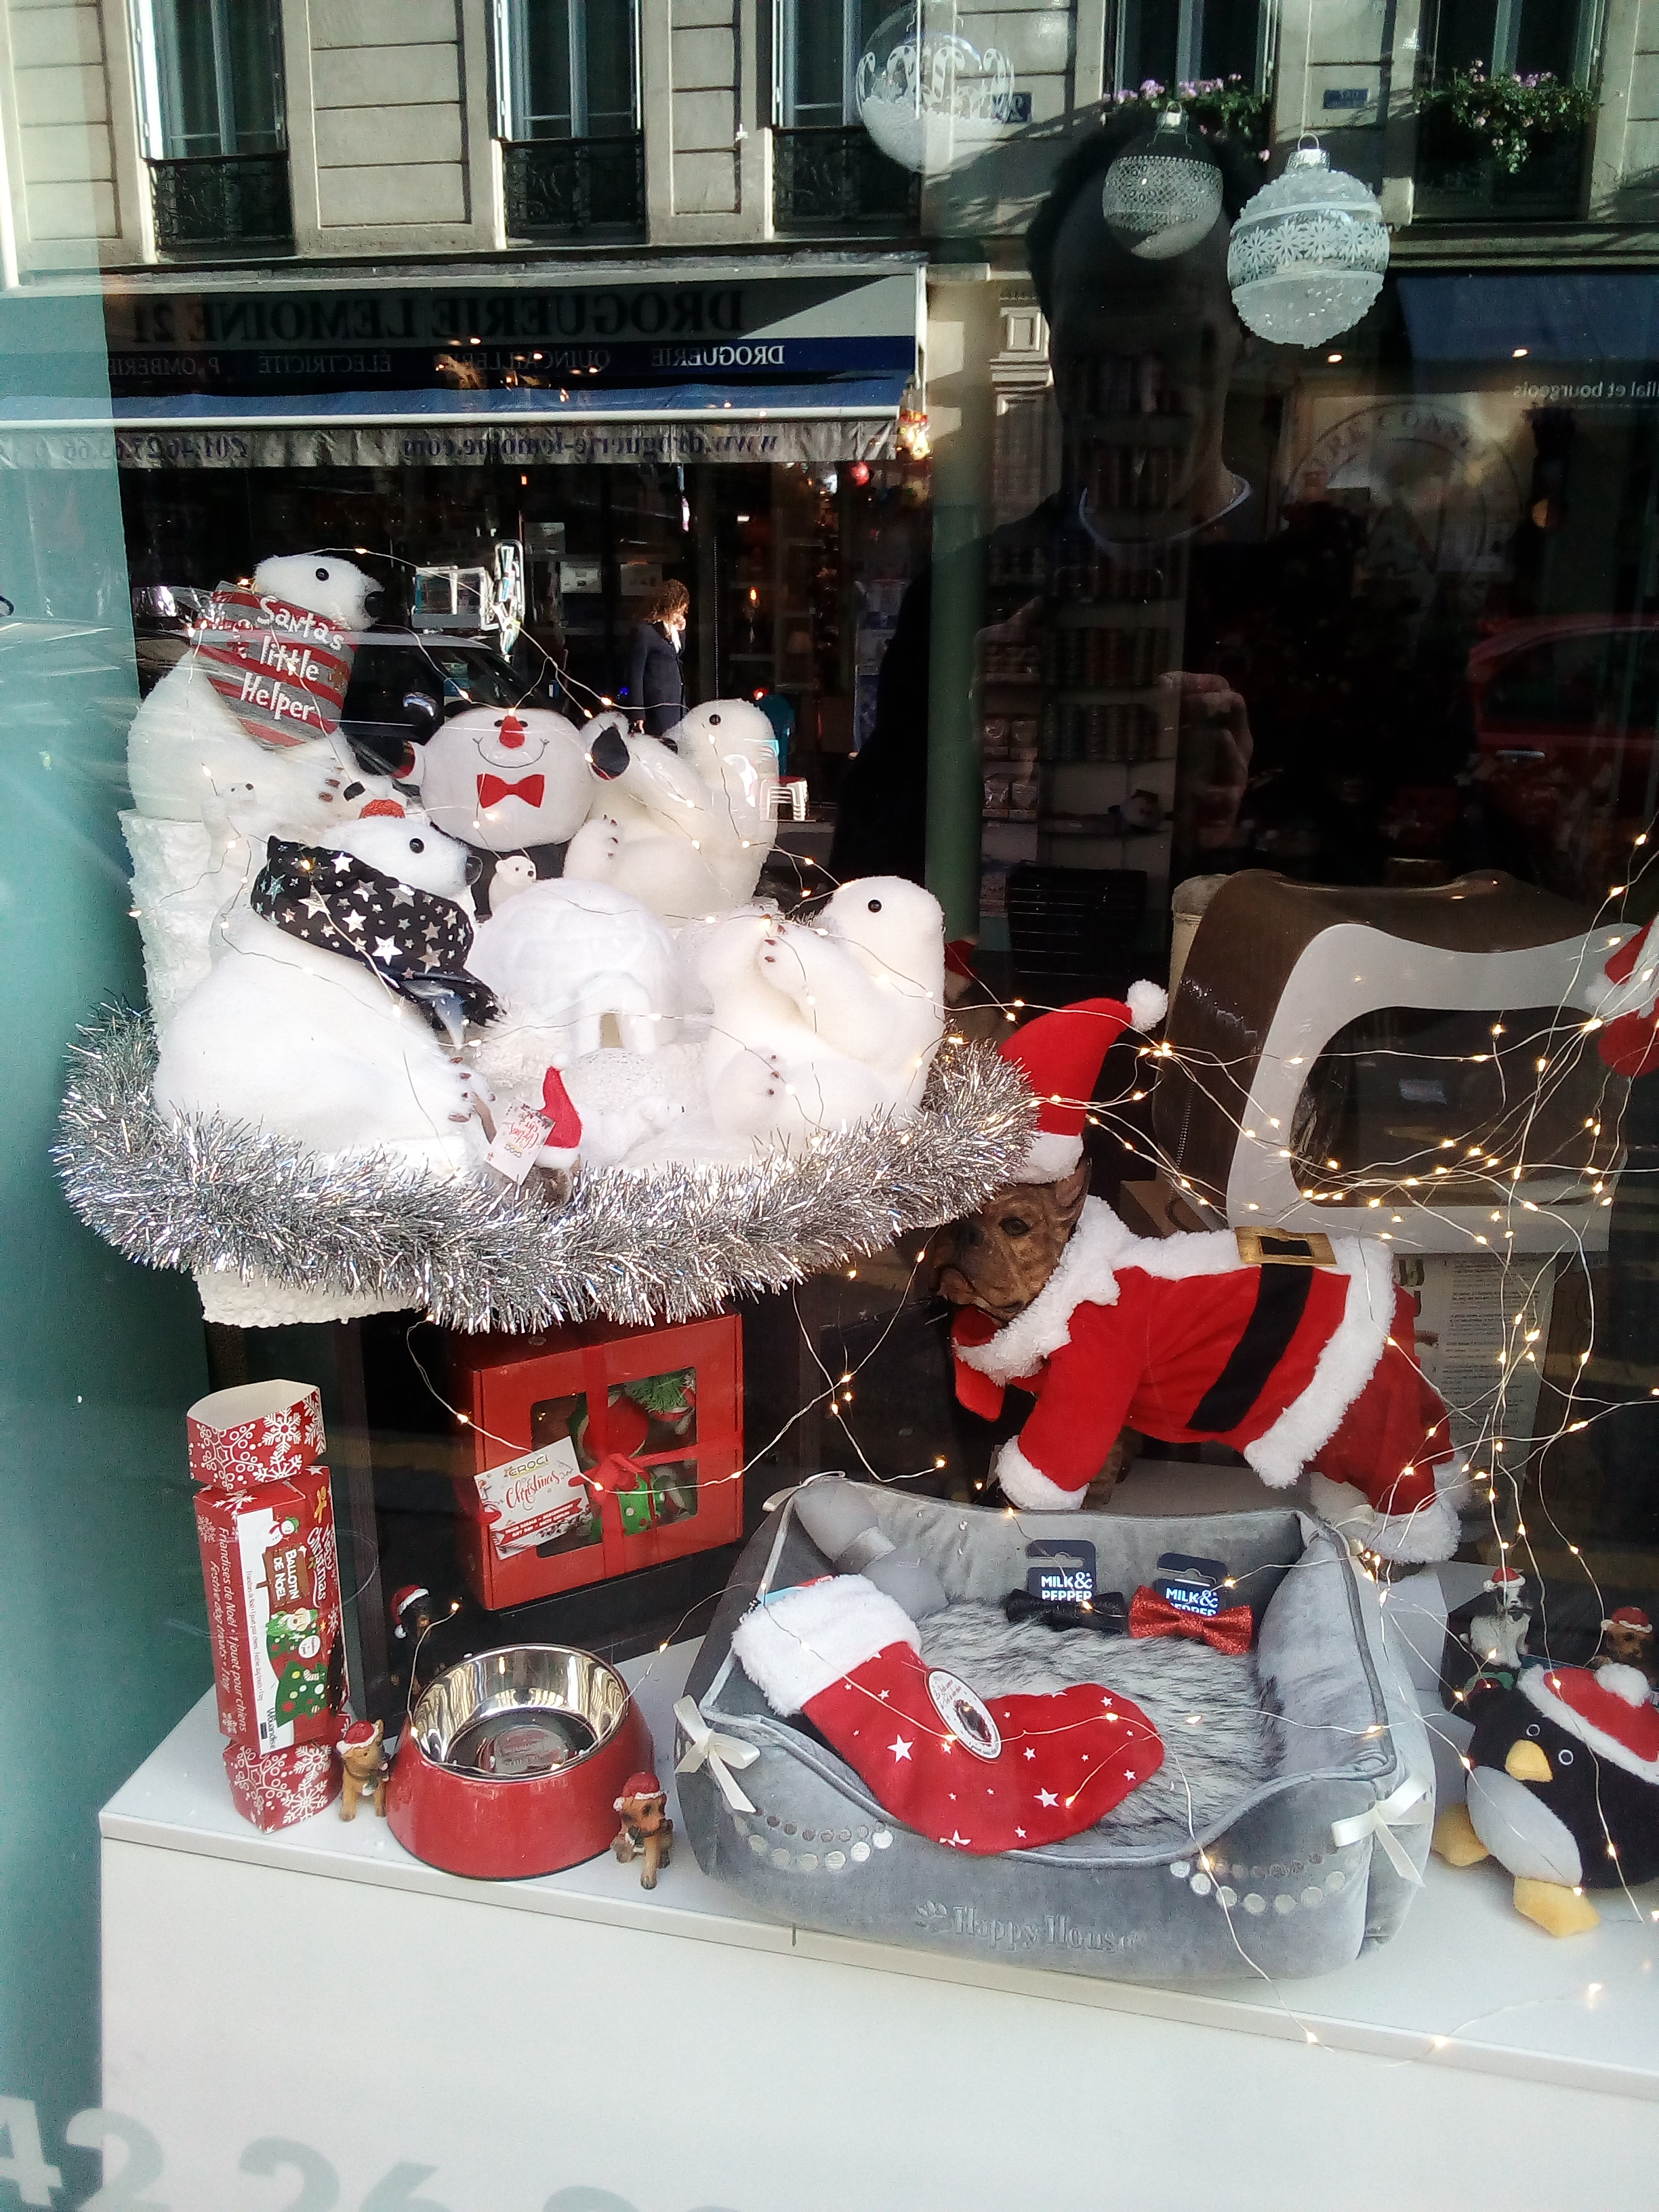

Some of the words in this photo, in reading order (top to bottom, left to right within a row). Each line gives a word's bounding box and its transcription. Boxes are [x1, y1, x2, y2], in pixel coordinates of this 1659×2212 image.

[260, 634, 320, 681] little
[241, 672, 316, 721] Helper
[506, 1470, 562, 1510] Christmas
[218, 1526, 232, 1585] Friandises
[274, 1557, 285, 1571] DE
[307, 1526, 327, 1601] Christmas
[275, 1572, 287, 1601] NOEL
[285, 1549, 300, 1600] BALLOTIN
[224, 1586, 235, 1601] de
[225, 1601, 238, 1628] Noël
[226, 1639, 241, 1673] jouet
[229, 1670, 243, 1699] pour
[235, 1698, 247, 1733] chiens
[953, 1905, 1040, 1952] Happy
[1044, 1914, 1139, 1953] House
